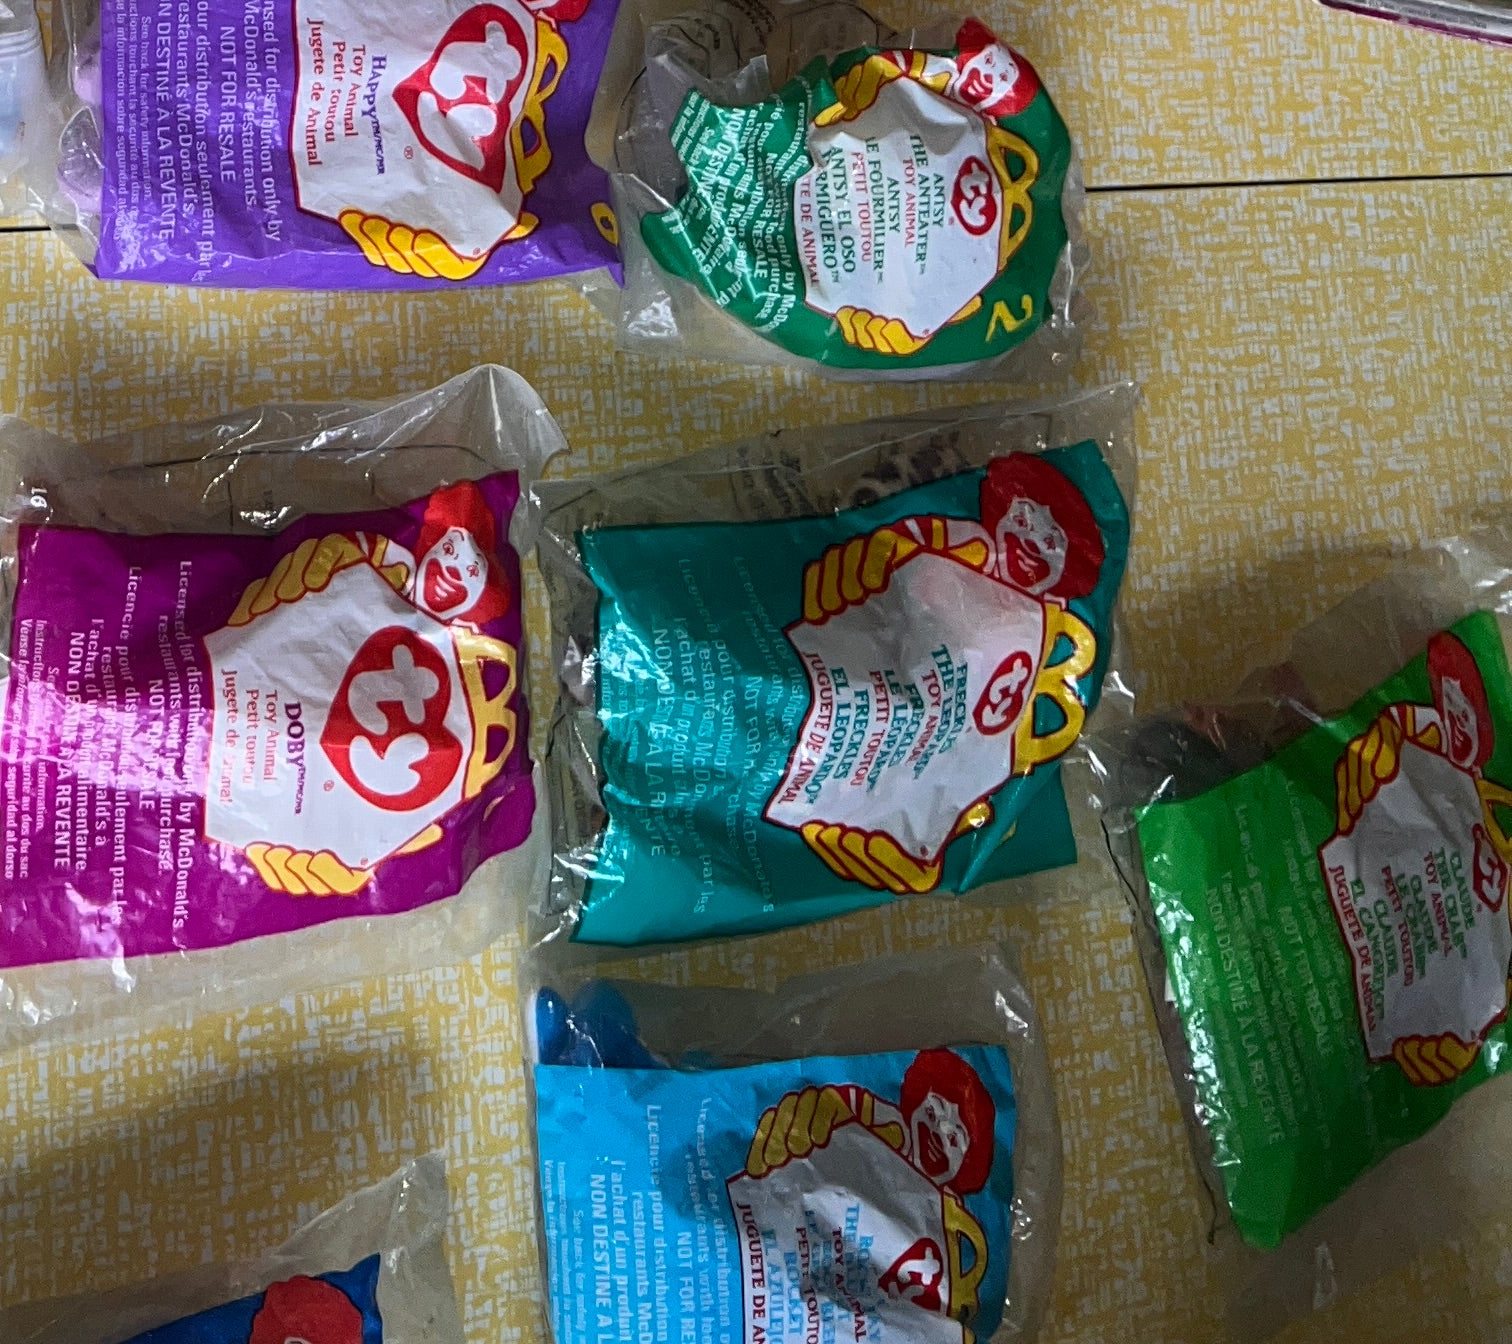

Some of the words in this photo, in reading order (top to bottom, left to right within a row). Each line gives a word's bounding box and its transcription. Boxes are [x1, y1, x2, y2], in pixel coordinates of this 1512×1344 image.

[155, 22, 173, 102] DESTINÉ
[219, 26, 236, 65] NOT
[264, 47, 280, 72] for
[306, 18, 325, 74] Jugete
[332, 41, 346, 82] Petit
[349, 44, 367, 76] Toy
[221, 71, 237, 107] FOR
[311, 82, 324, 102] de
[324, 89, 341, 143] toutou
[344, 83, 361, 138] Animal
[416, 21, 522, 171] ty
[156, 126, 173, 150] LA
[219, 111, 236, 183] RESALE
[258, 77, 281, 173] distribution
[306, 108, 322, 166] Animal
[909, 135, 929, 168] THE
[157, 155, 176, 240] REVENTE
[262, 177, 280, 213] only
[903, 158, 916, 188] TOY
[959, 162, 989, 228] ty
[800, 202, 814, 225] DE
[837, 210, 851, 230] EL
[868, 160, 885, 271] FOURMILIER
[904, 192, 915, 248] ANIMAL
[916, 173, 930, 263] ANTEATER
[932, 173, 945, 228] ANTSY
[264, 220, 282, 241] by
[841, 236, 855, 273] OSO
[858, 202, 871, 263] TOUTOU
[67, 632, 85, 674] NON
[930, 644, 954, 691] THE
[221, 669, 238, 723] Jugete
[246, 689, 259, 729] Petit
[264, 690, 277, 724] Toy
[803, 652, 833, 732] JUGUETE
[869, 671, 890, 724] PETIT
[921, 670, 941, 708] TOY
[284, 703, 305, 768] DOBY
[348, 645, 439, 796] ty
[808, 733, 826, 753] DE
[833, 689, 869, 780] FRECKLES
[850, 729, 886, 786] TOUTOU
[53, 784, 71, 870] REVENTE
[171, 828, 193, 929] McDonald's
[1423, 851, 1439, 886] TOY
[1328, 865, 1365, 942] JUGUETE
[677, 1231, 694, 1269] NOT
[736, 1202, 765, 1289] JUGUETE
[751, 1294, 767, 1319] DE
